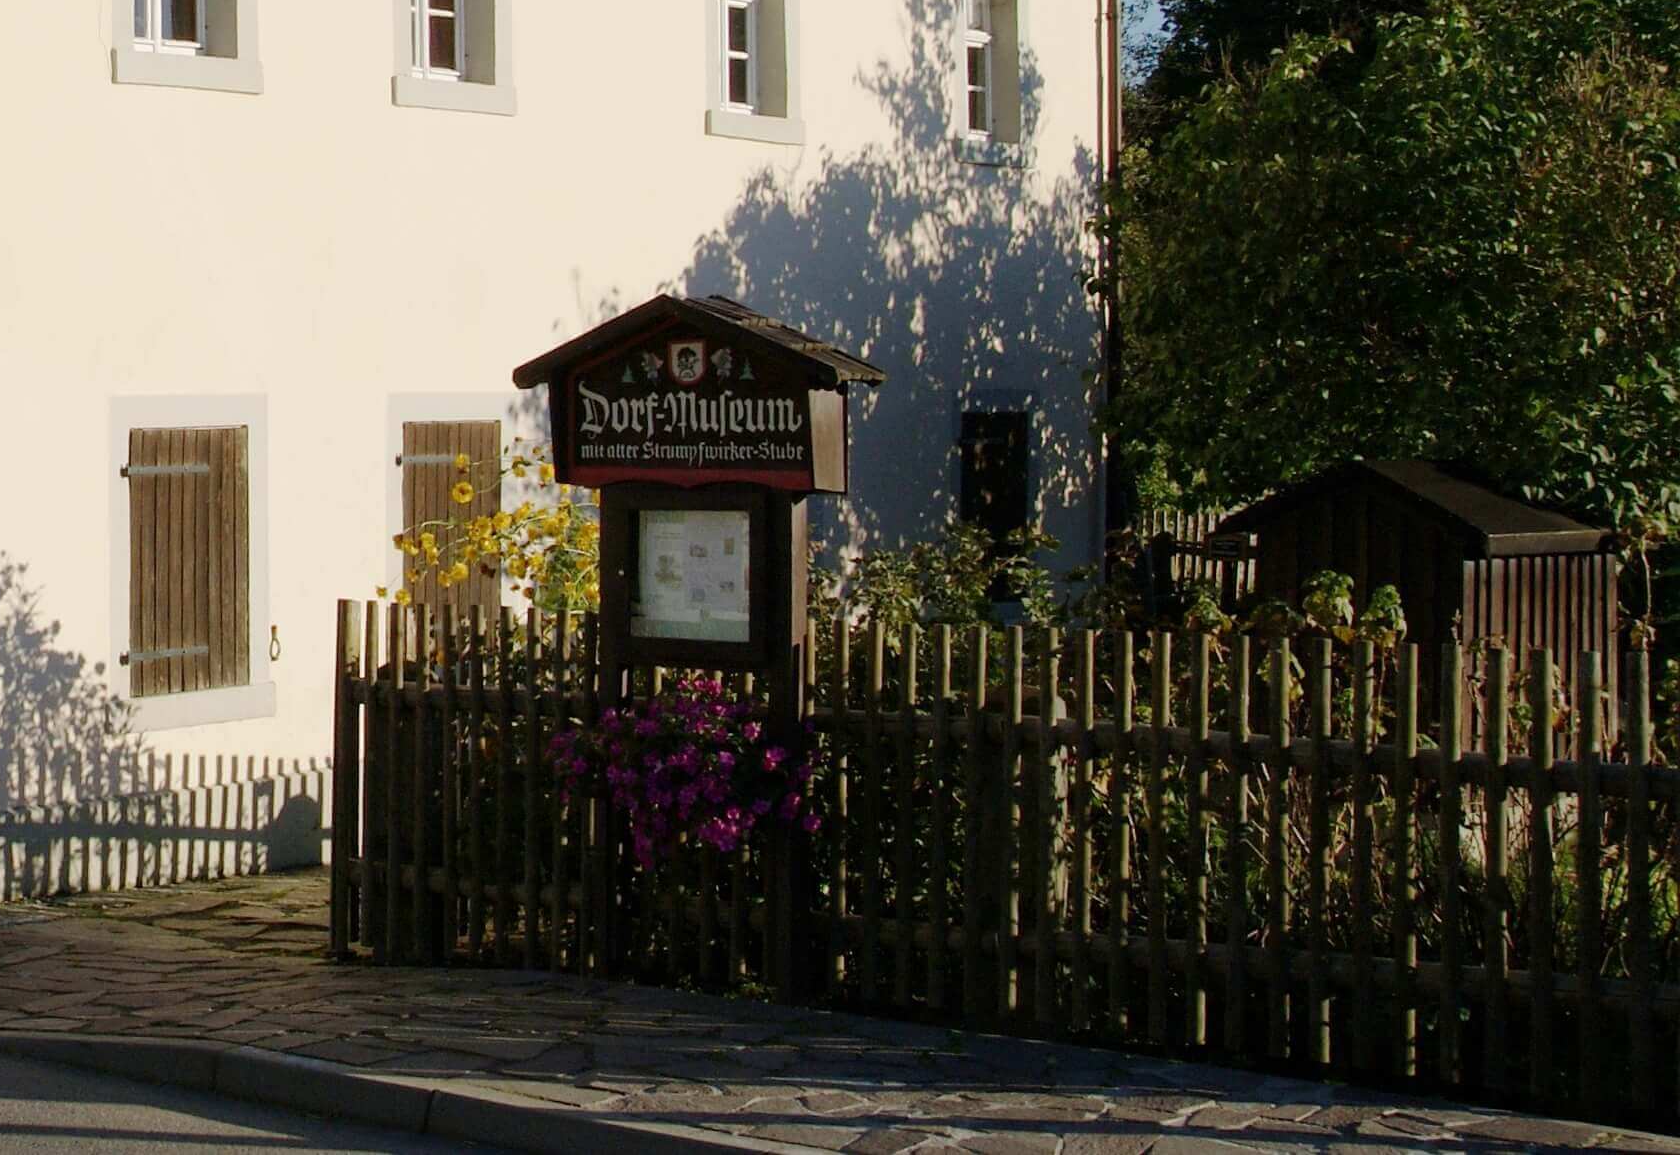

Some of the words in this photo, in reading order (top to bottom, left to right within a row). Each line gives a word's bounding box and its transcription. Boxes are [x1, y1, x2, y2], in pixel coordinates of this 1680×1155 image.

[578, 380, 803, 439] Dorf-Museum
[581, 443, 604, 459] mit
[607, 443, 639, 459] alter
[642, 440, 803, 466] Strumpfwirker-Stube
